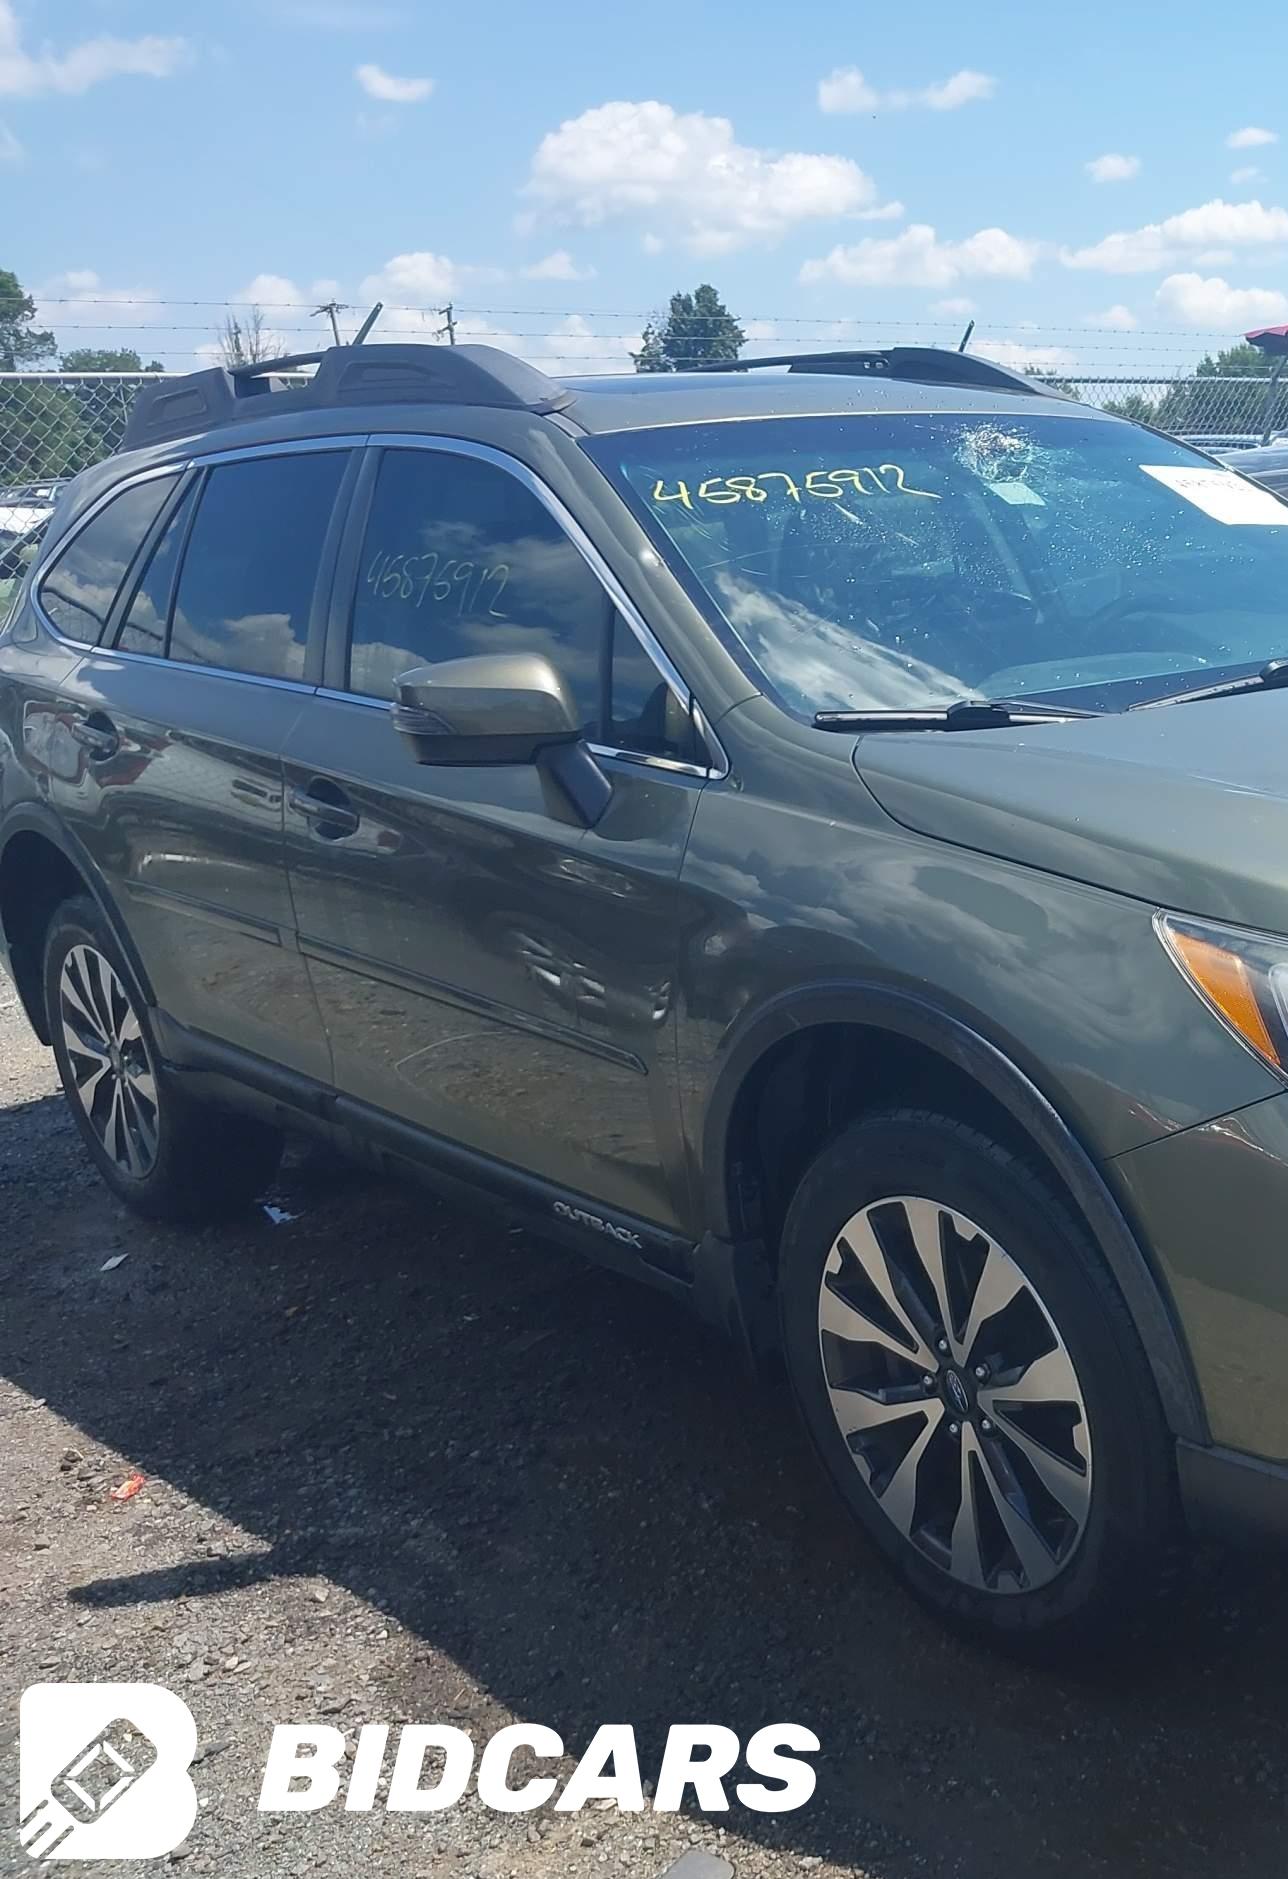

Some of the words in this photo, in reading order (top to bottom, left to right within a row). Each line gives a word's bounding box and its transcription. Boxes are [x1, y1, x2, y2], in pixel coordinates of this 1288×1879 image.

[653, 464, 942, 509] 45875912
[367, 551, 509, 617] 45875912
[553, 1201, 642, 1249] OUTBACK
